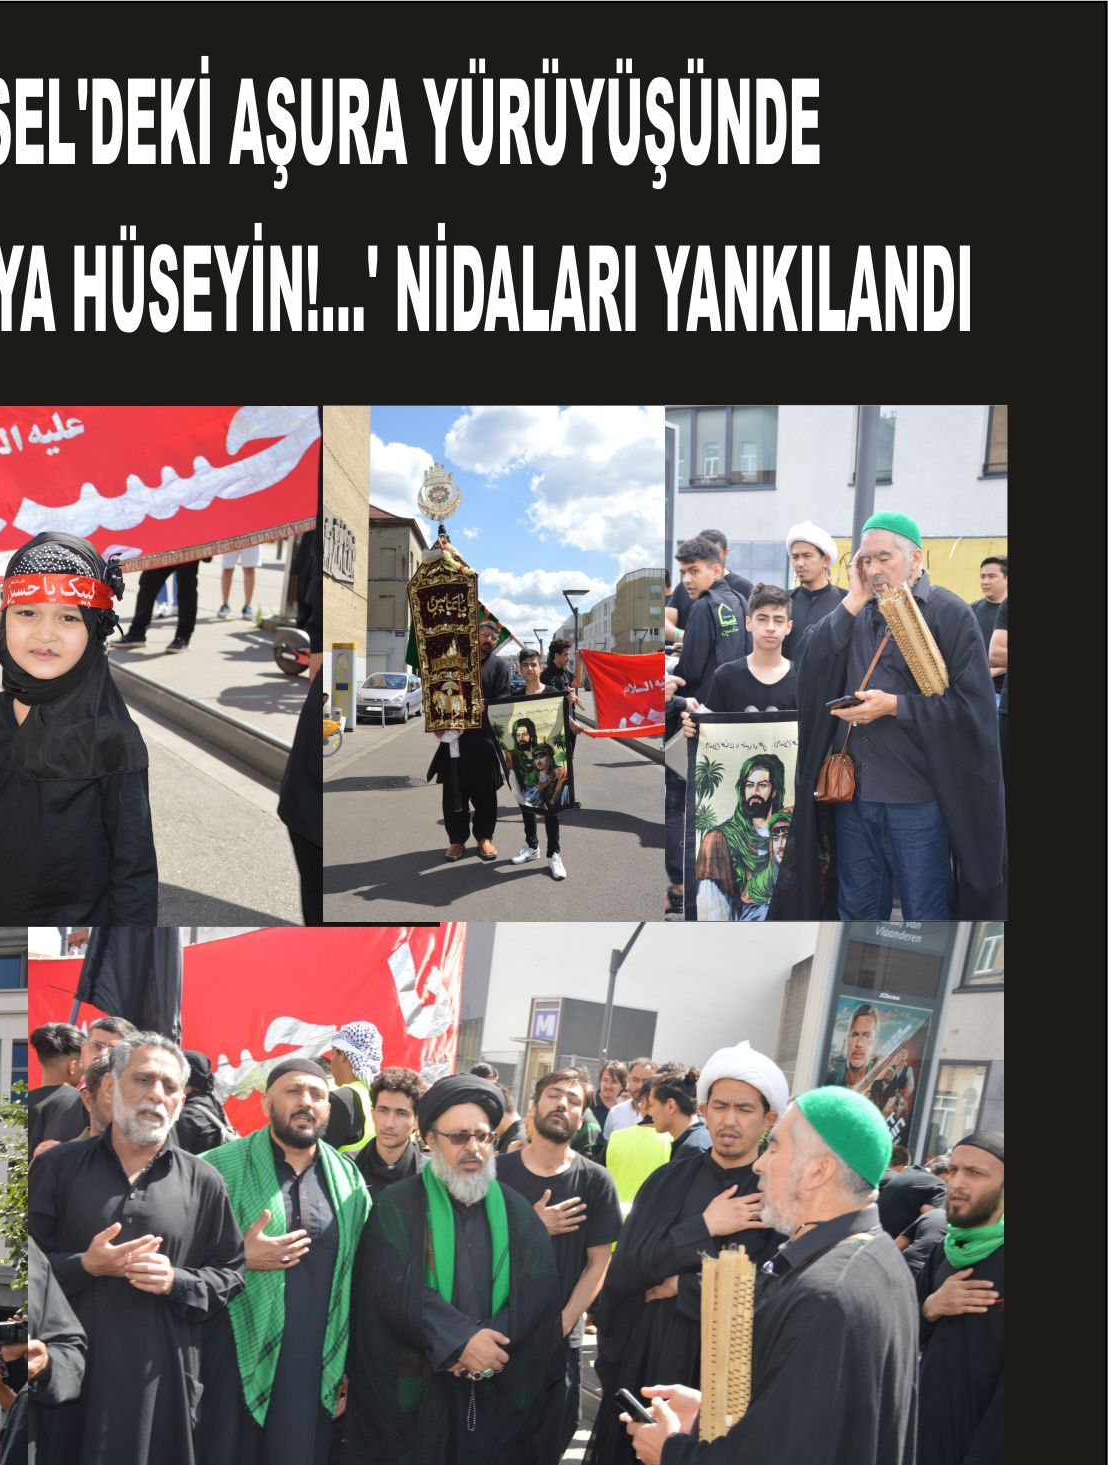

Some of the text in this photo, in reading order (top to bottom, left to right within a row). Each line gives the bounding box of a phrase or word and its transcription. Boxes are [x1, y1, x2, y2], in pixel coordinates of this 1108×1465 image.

[27, 411, 85, 455] عليه
[875, 926, 922, 944] Vlaanderen
[535, 1014, 557, 1037] M
